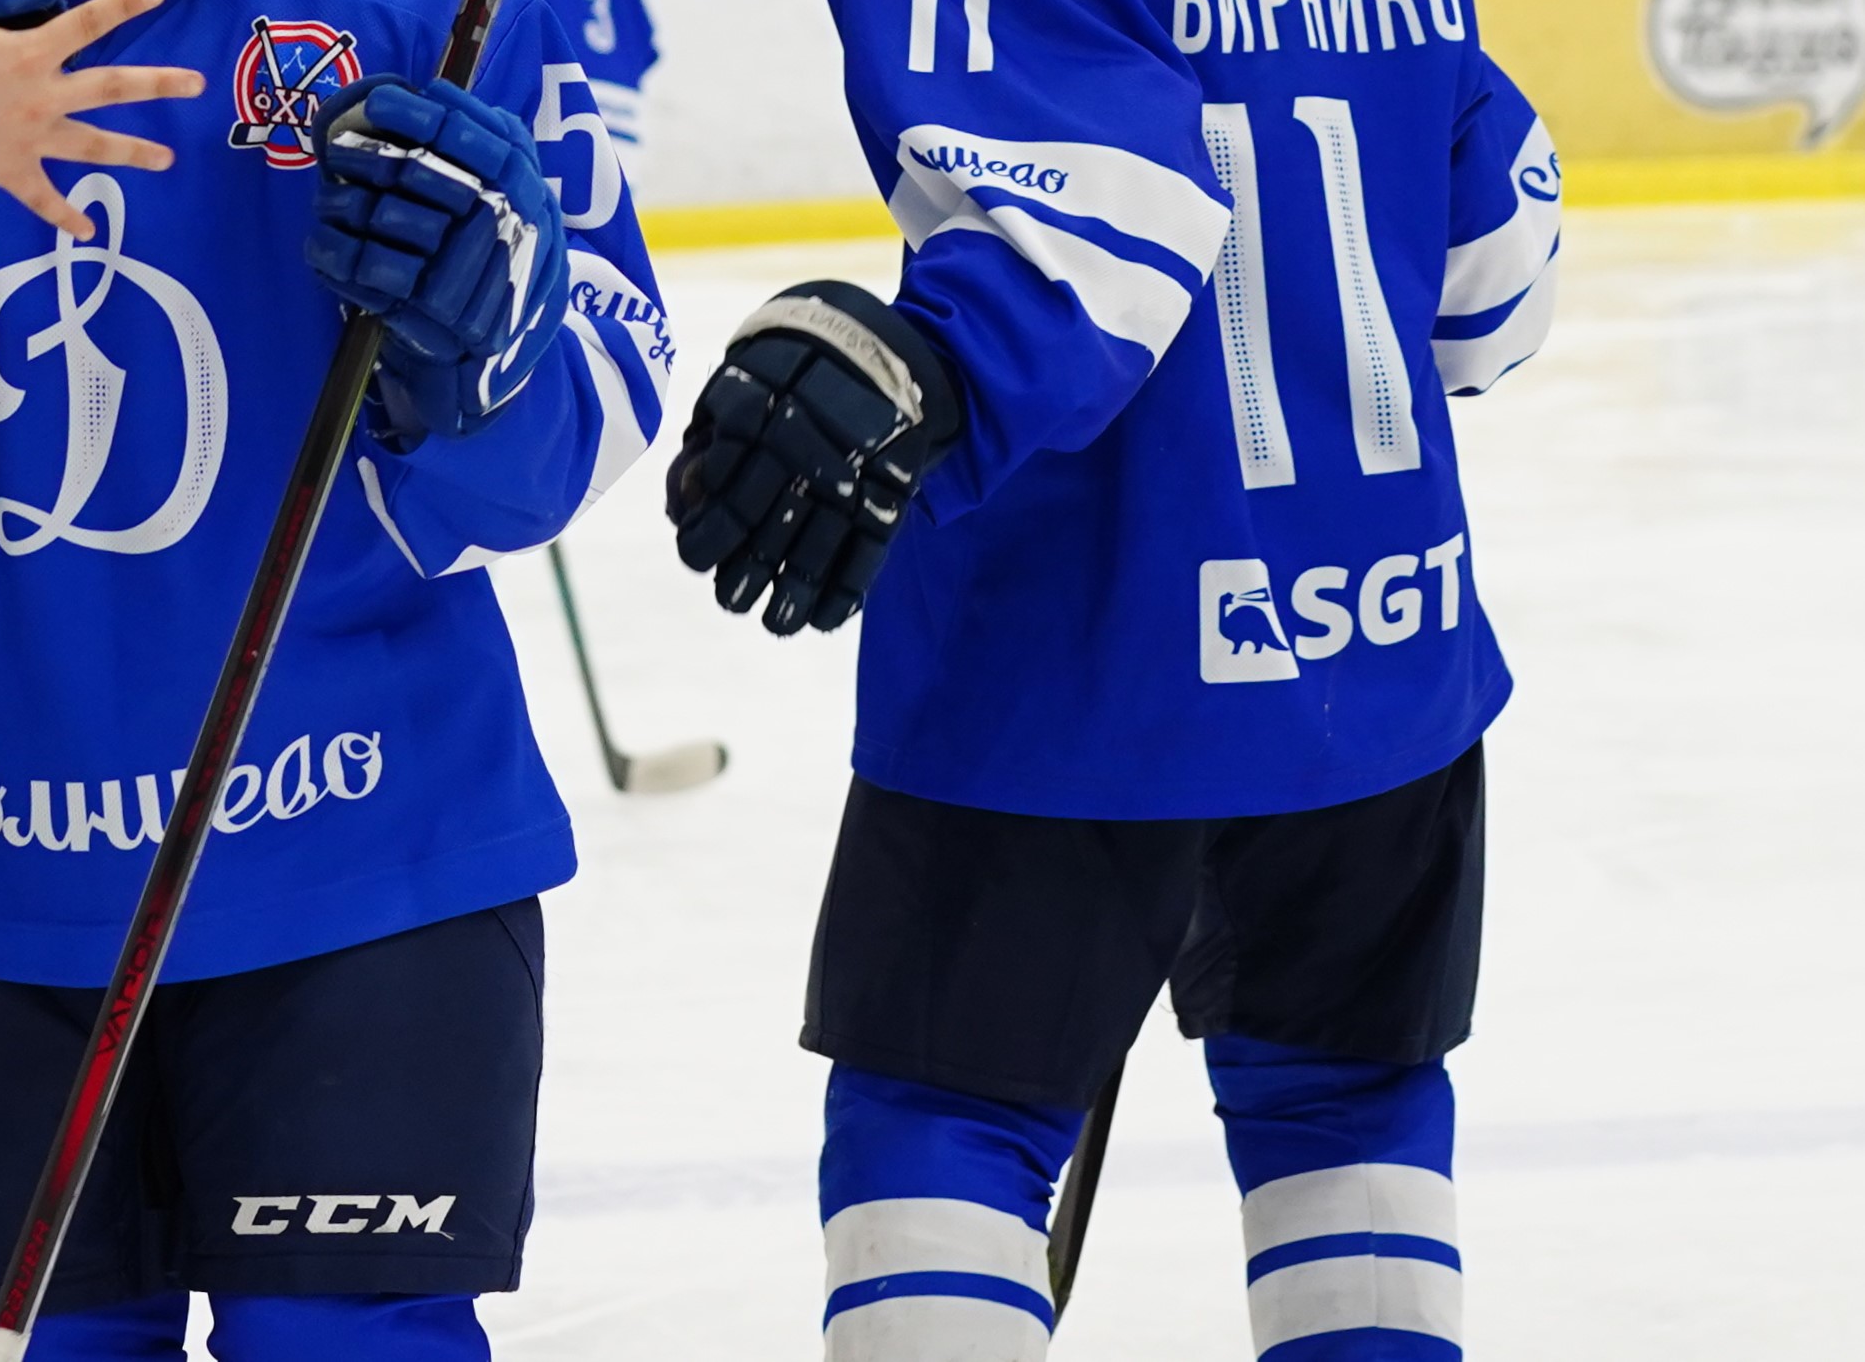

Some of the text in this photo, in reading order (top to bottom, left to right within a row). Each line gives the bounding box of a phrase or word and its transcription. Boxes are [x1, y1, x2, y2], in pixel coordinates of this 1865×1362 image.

[533, 62, 622, 230] 5
[1202, 97, 1422, 490] 11
[1290, 531, 1465, 661] SGT
[231, 1194, 457, 1237] CCM
